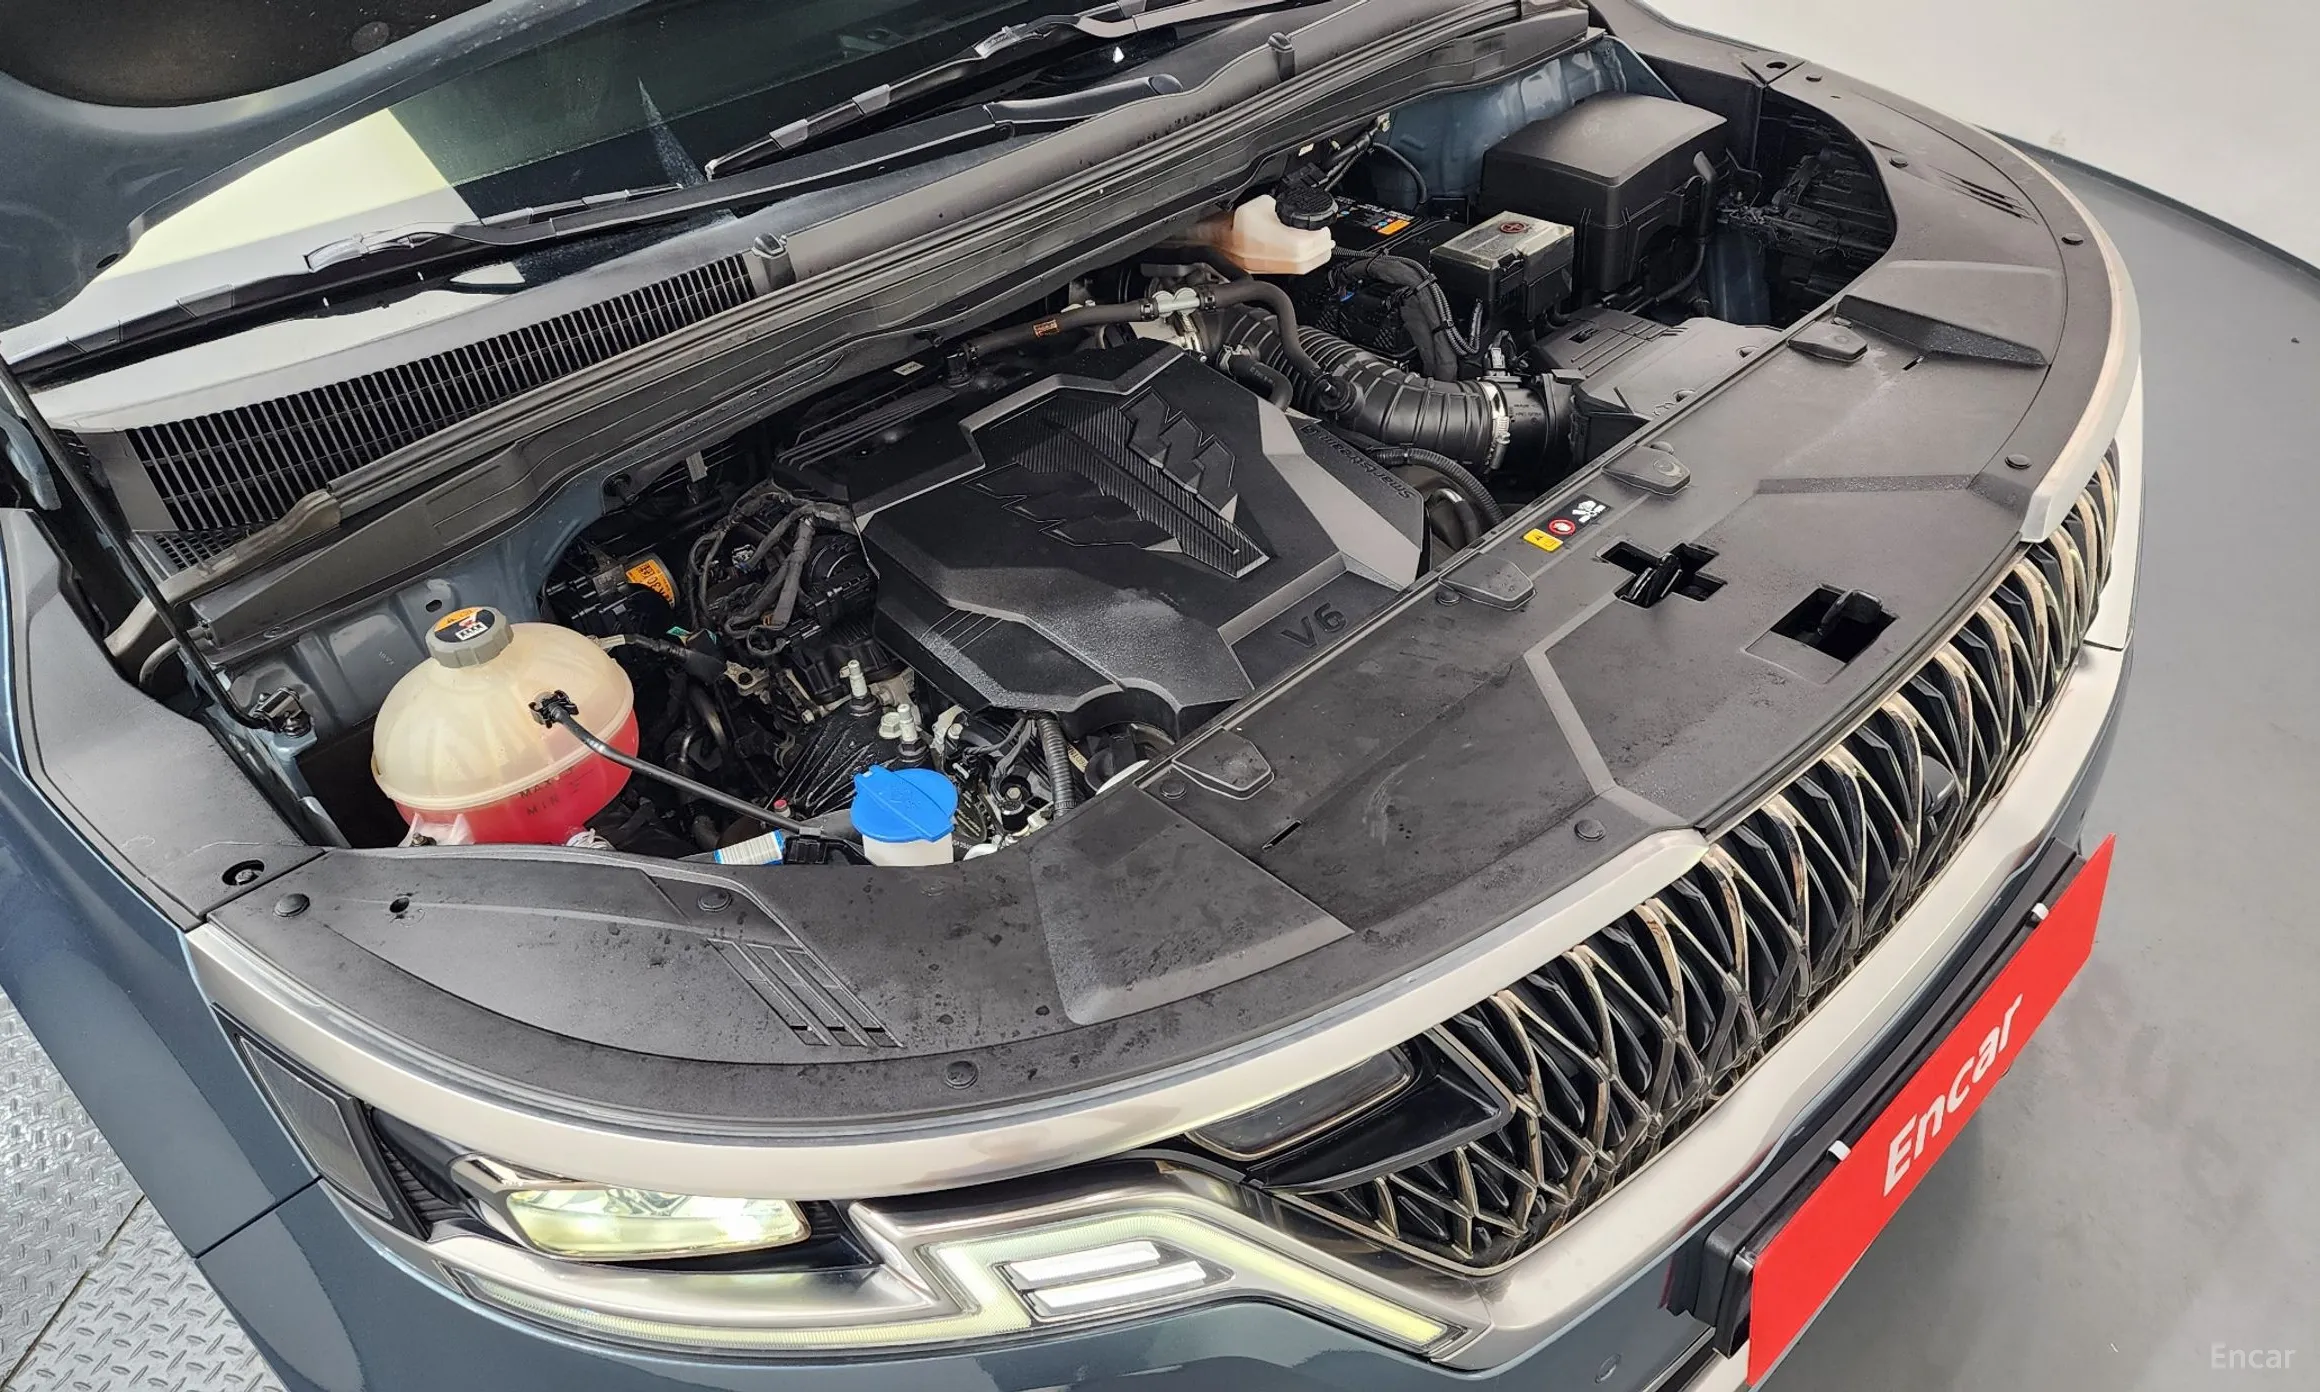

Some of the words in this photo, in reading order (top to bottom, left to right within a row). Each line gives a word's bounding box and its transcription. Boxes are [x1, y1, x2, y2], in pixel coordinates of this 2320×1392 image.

[1319, 434, 1416, 499] Smartstream
[1281, 602, 1347, 648] V6
[520, 779, 551, 798] MAX
[527, 795, 560, 815] MIN
[1883, 993, 2024, 1197] Encar
